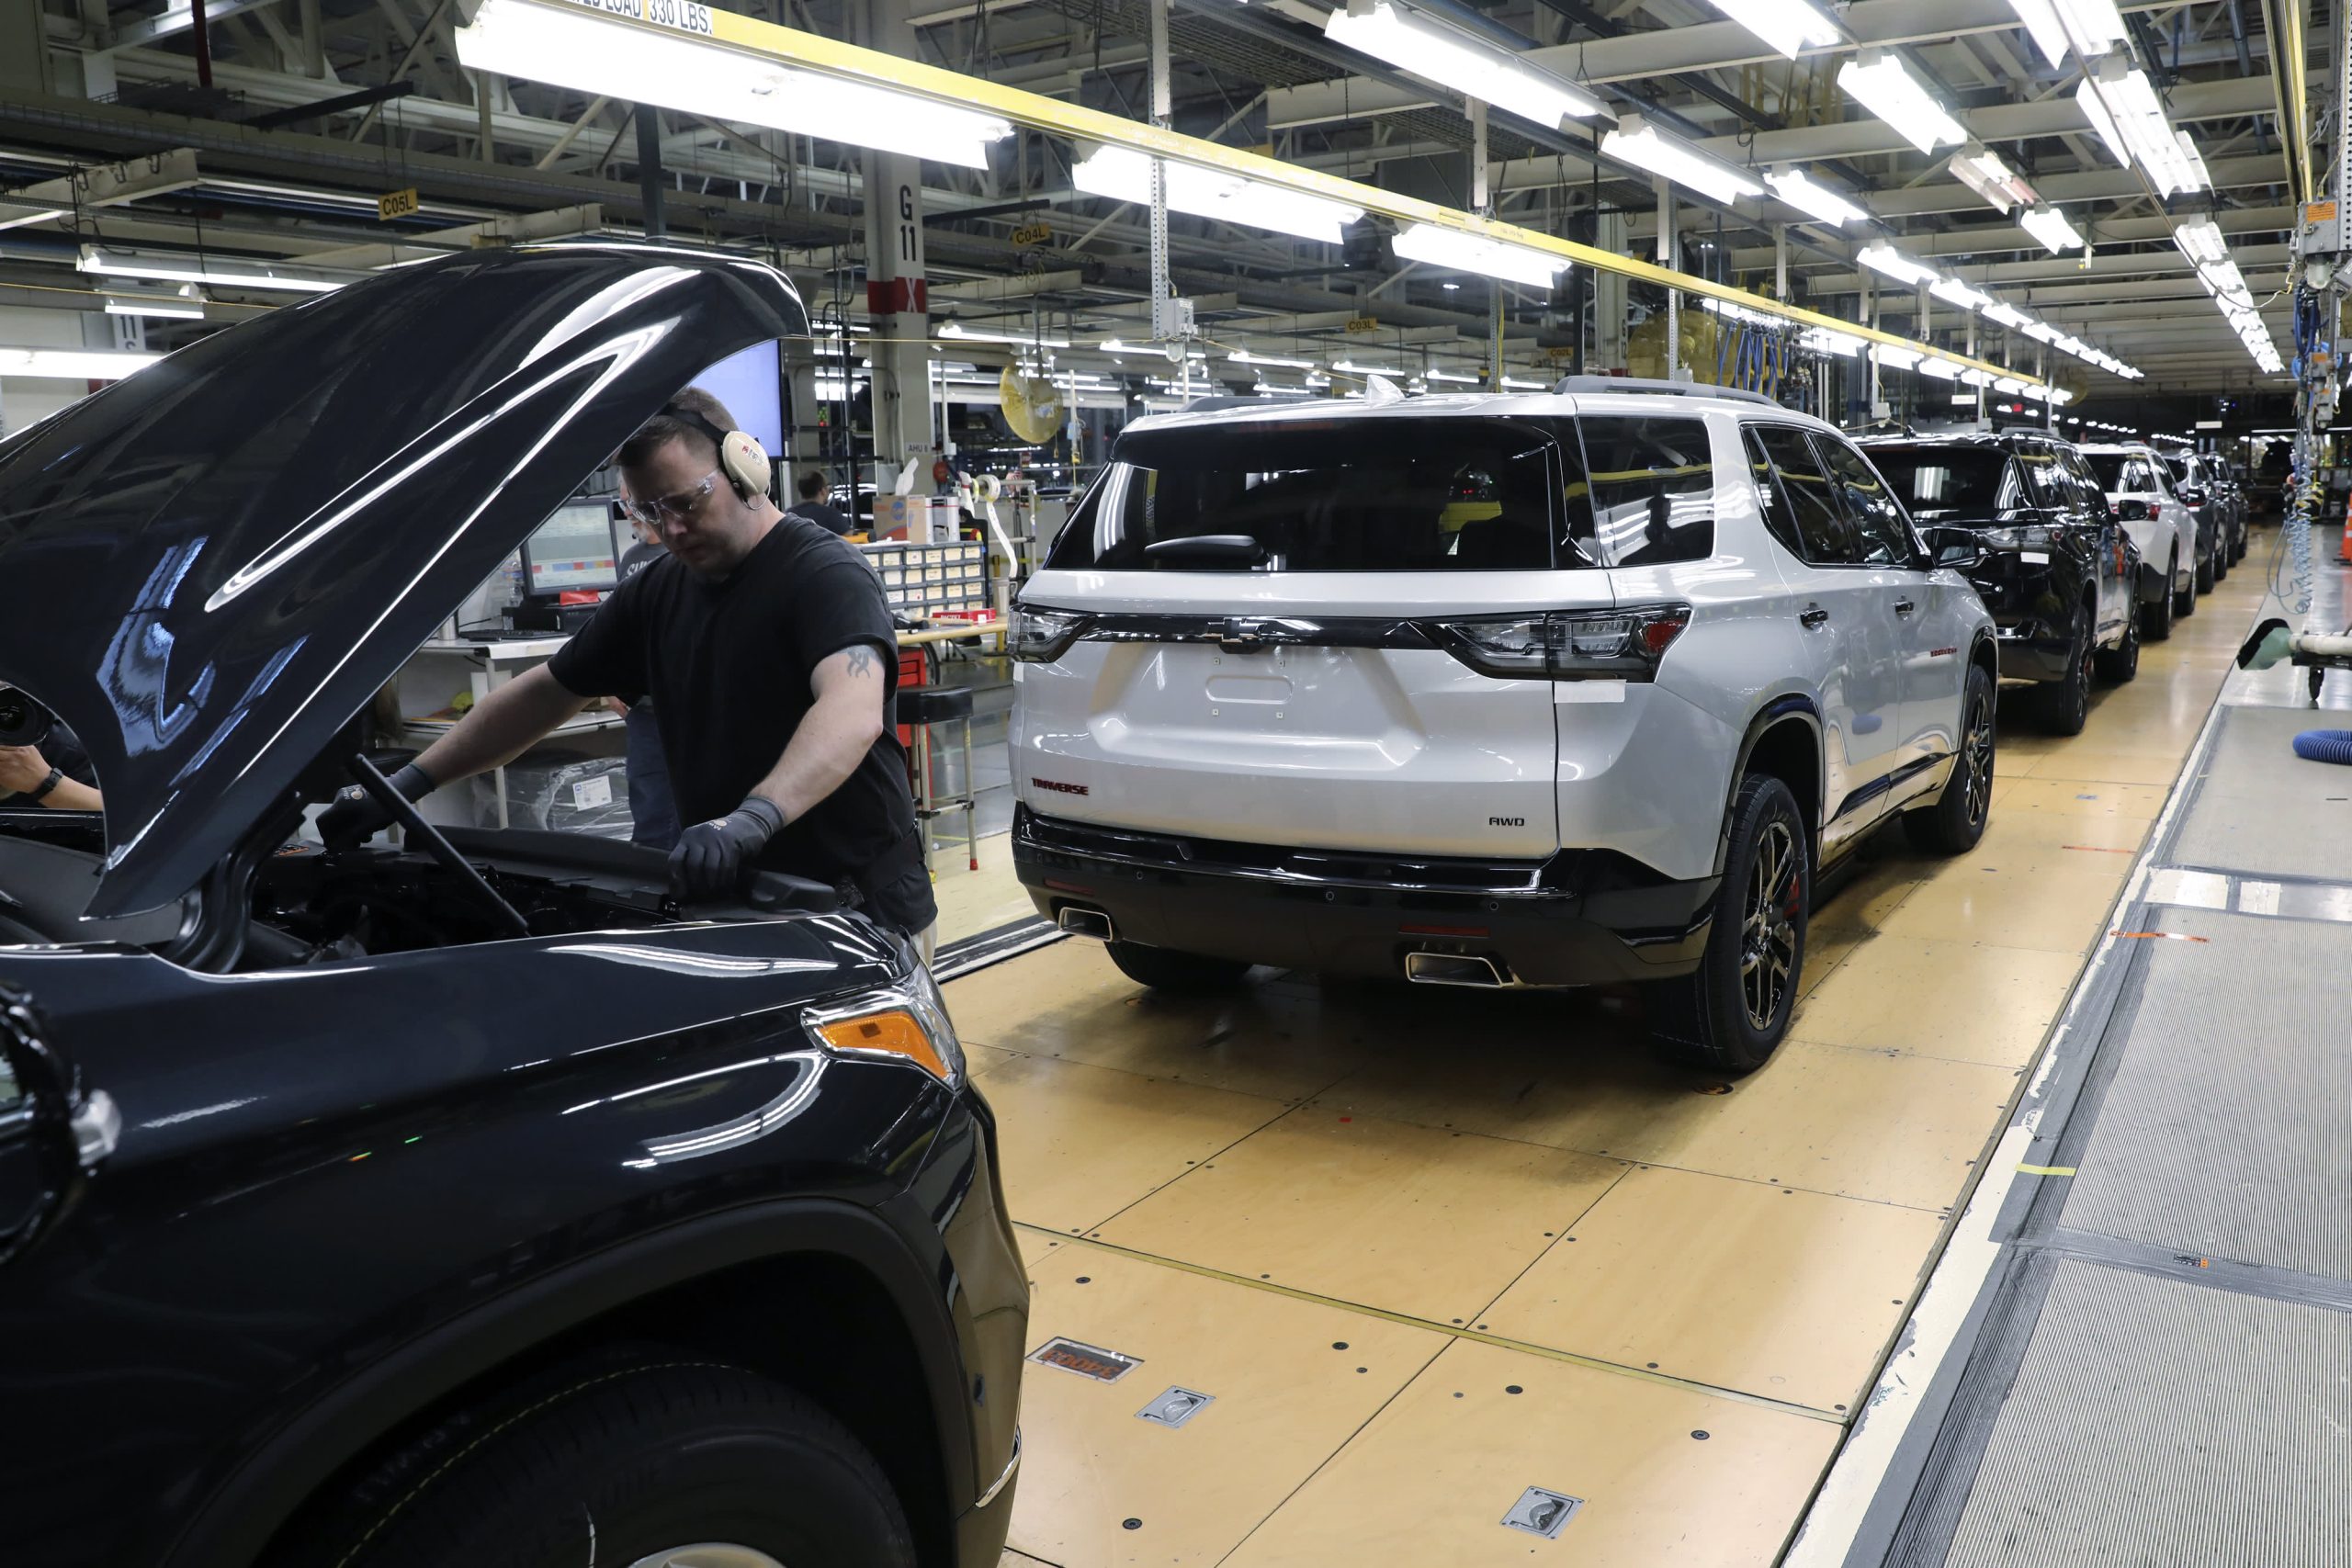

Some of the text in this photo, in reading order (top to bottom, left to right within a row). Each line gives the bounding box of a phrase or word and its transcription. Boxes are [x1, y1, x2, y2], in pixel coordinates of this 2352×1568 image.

[650, 0, 674, 25] 330
[678, 1, 712, 34] LBS.
[382, 194, 413, 215] C05L
[899, 185, 913, 220] G
[900, 225, 917, 262] 11
[1031, 777, 1090, 796] TRAVERSE
[1488, 817, 1525, 827] AWD
